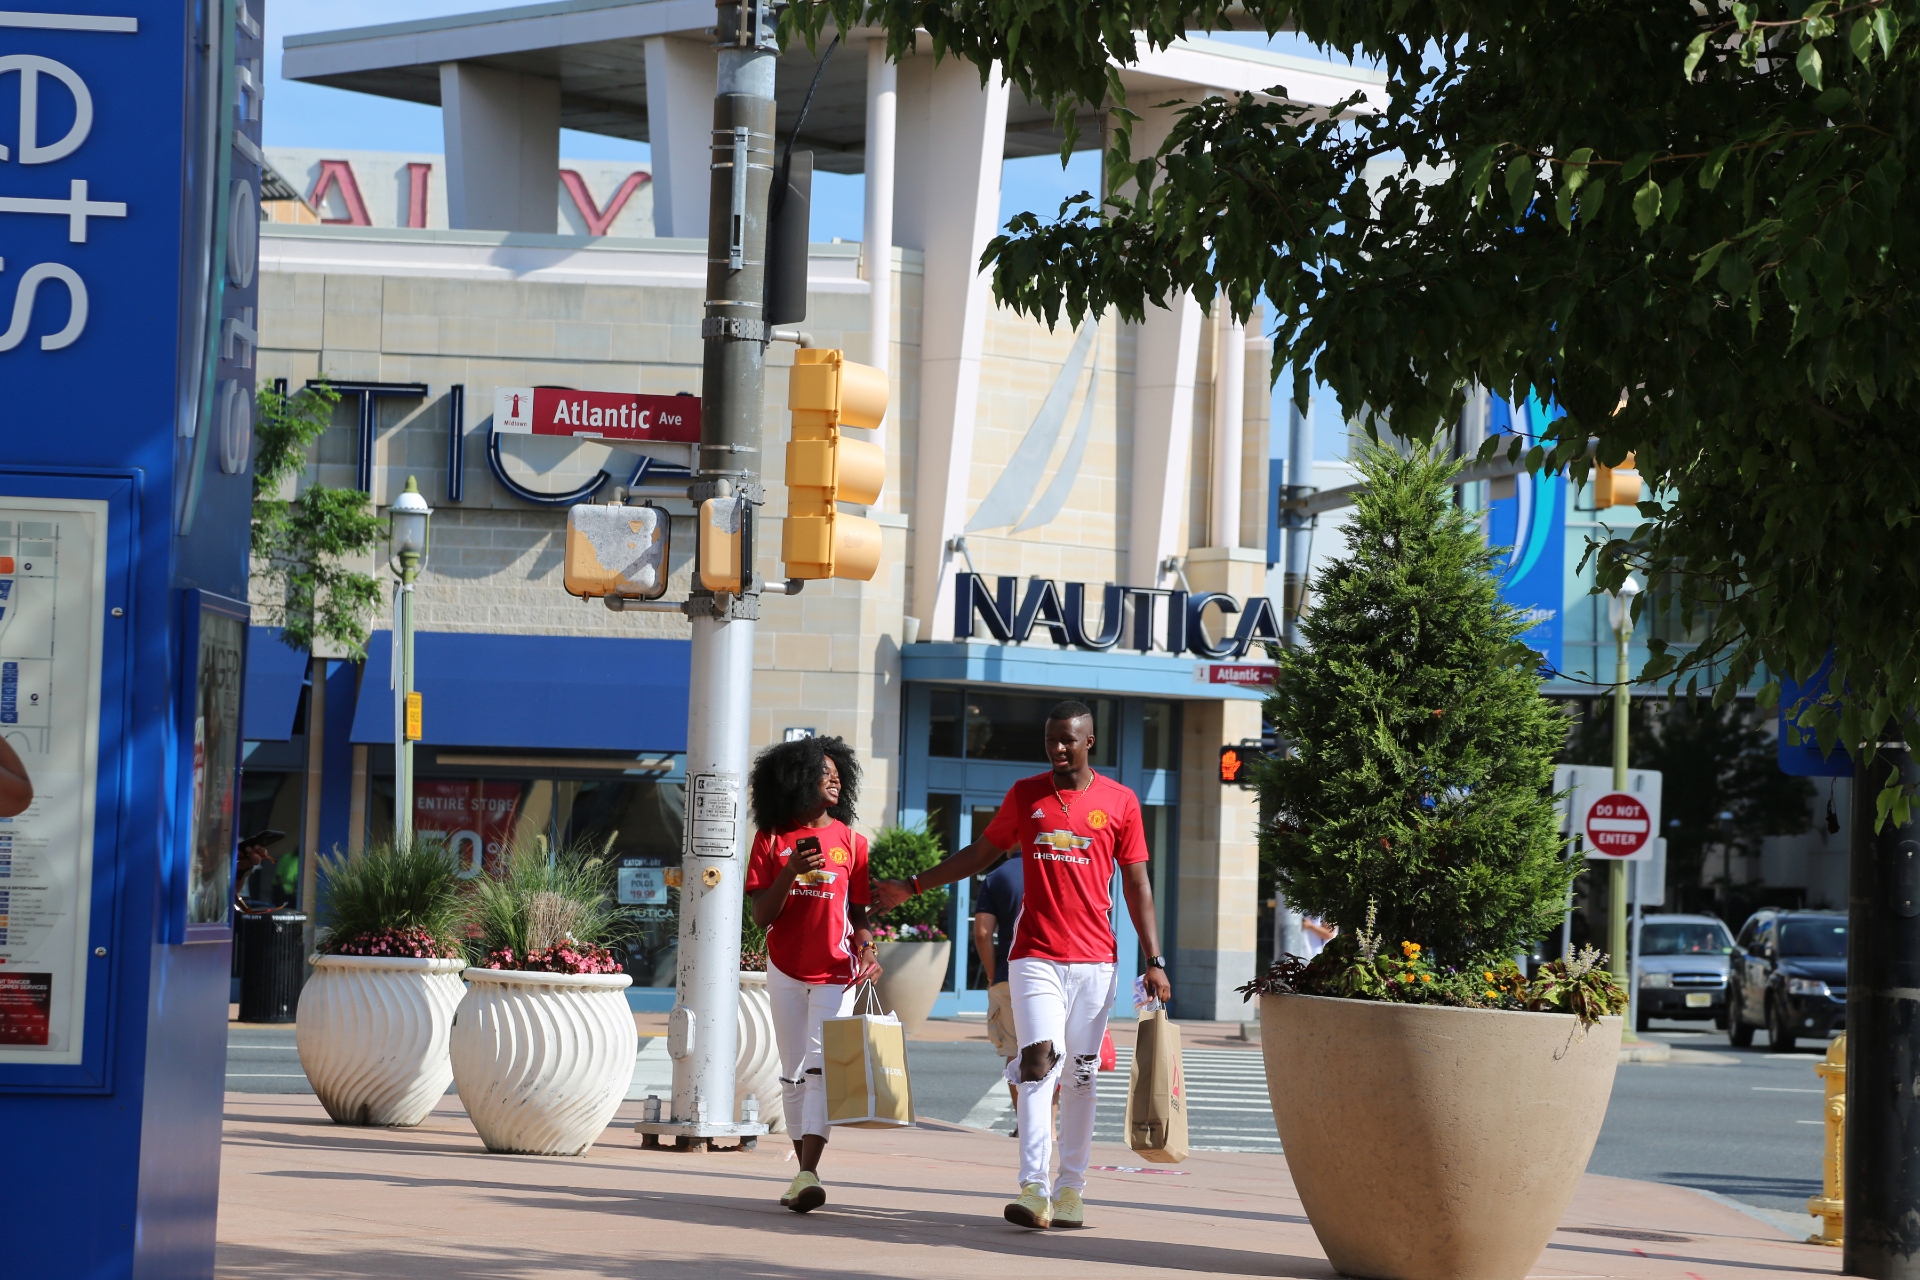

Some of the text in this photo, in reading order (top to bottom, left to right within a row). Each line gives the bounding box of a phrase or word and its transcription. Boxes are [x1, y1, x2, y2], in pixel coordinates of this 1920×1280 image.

[553, 399, 682, 429] Atlantic Ave
[503, 419, 528, 427] Midtown
[954, 571, 1283, 658] NAUTICA
[1217, 668, 1260, 681] Atlantic
[417, 796, 514, 811] ENTIRE STORE
[1596, 805, 1641, 818] DO NOT
[1598, 832, 1638, 846] ENTER
[1033, 852, 1091, 865] CHEVROLET
[631, 879, 655, 888] POLOS
[789, 888, 836, 901] HEVROLET
